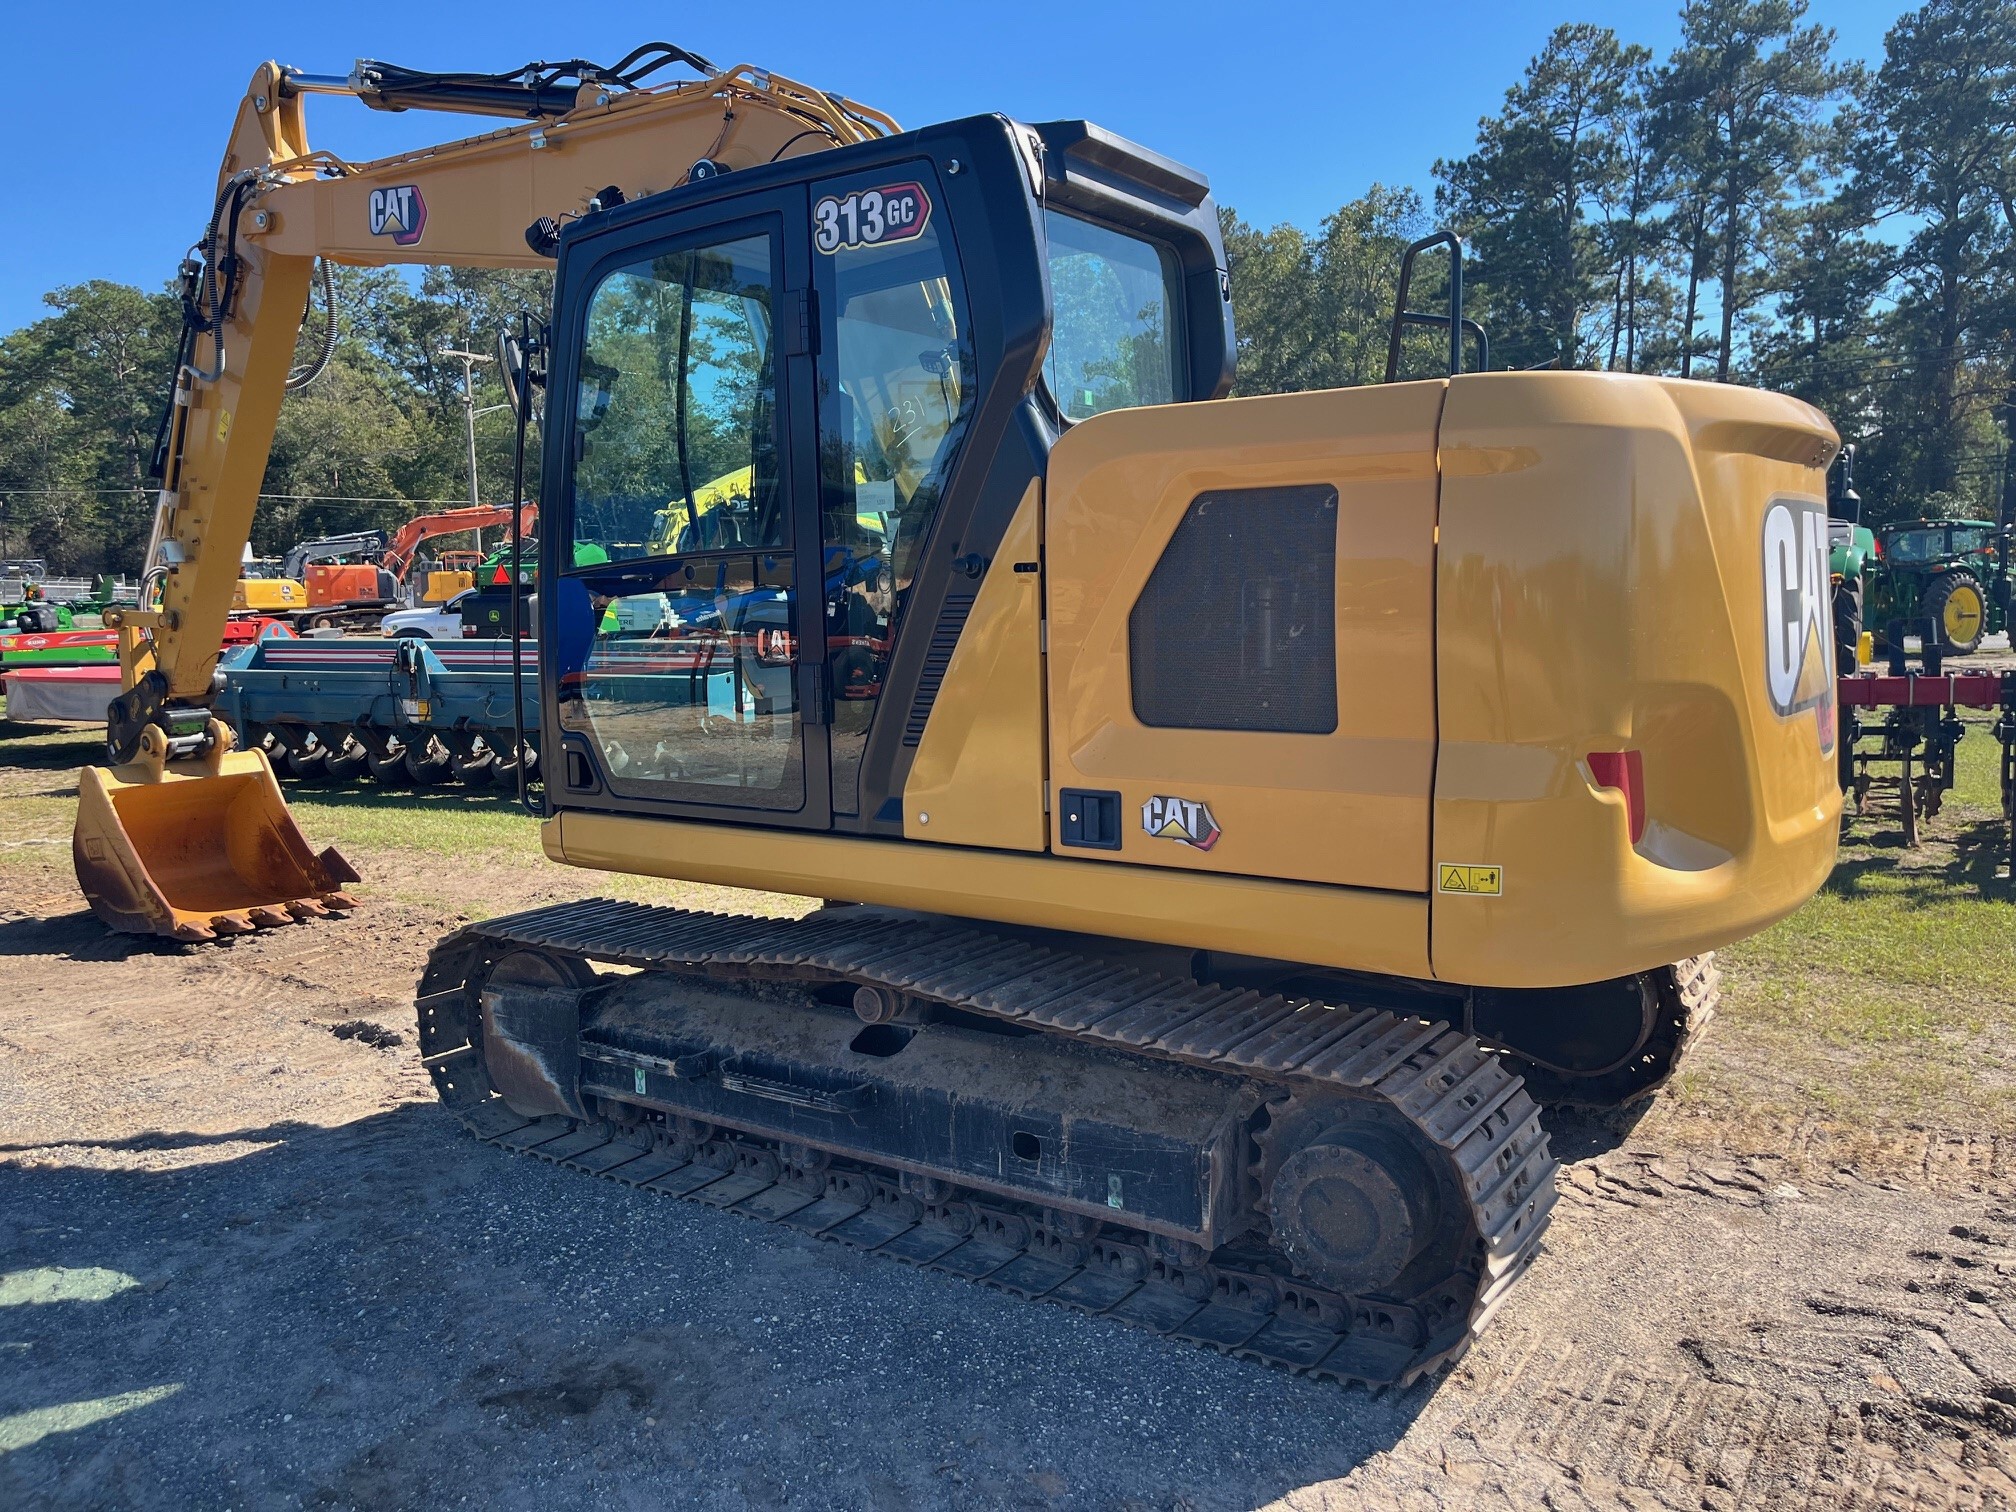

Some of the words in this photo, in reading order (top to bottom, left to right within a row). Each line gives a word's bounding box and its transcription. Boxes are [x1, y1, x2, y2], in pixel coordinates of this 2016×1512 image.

[369, 186, 412, 235] CAT
[815, 191, 885, 250] 313
[887, 196, 914, 226] GC
[887, 395, 926, 433] 231
[1142, 797, 1203, 840] CAT
